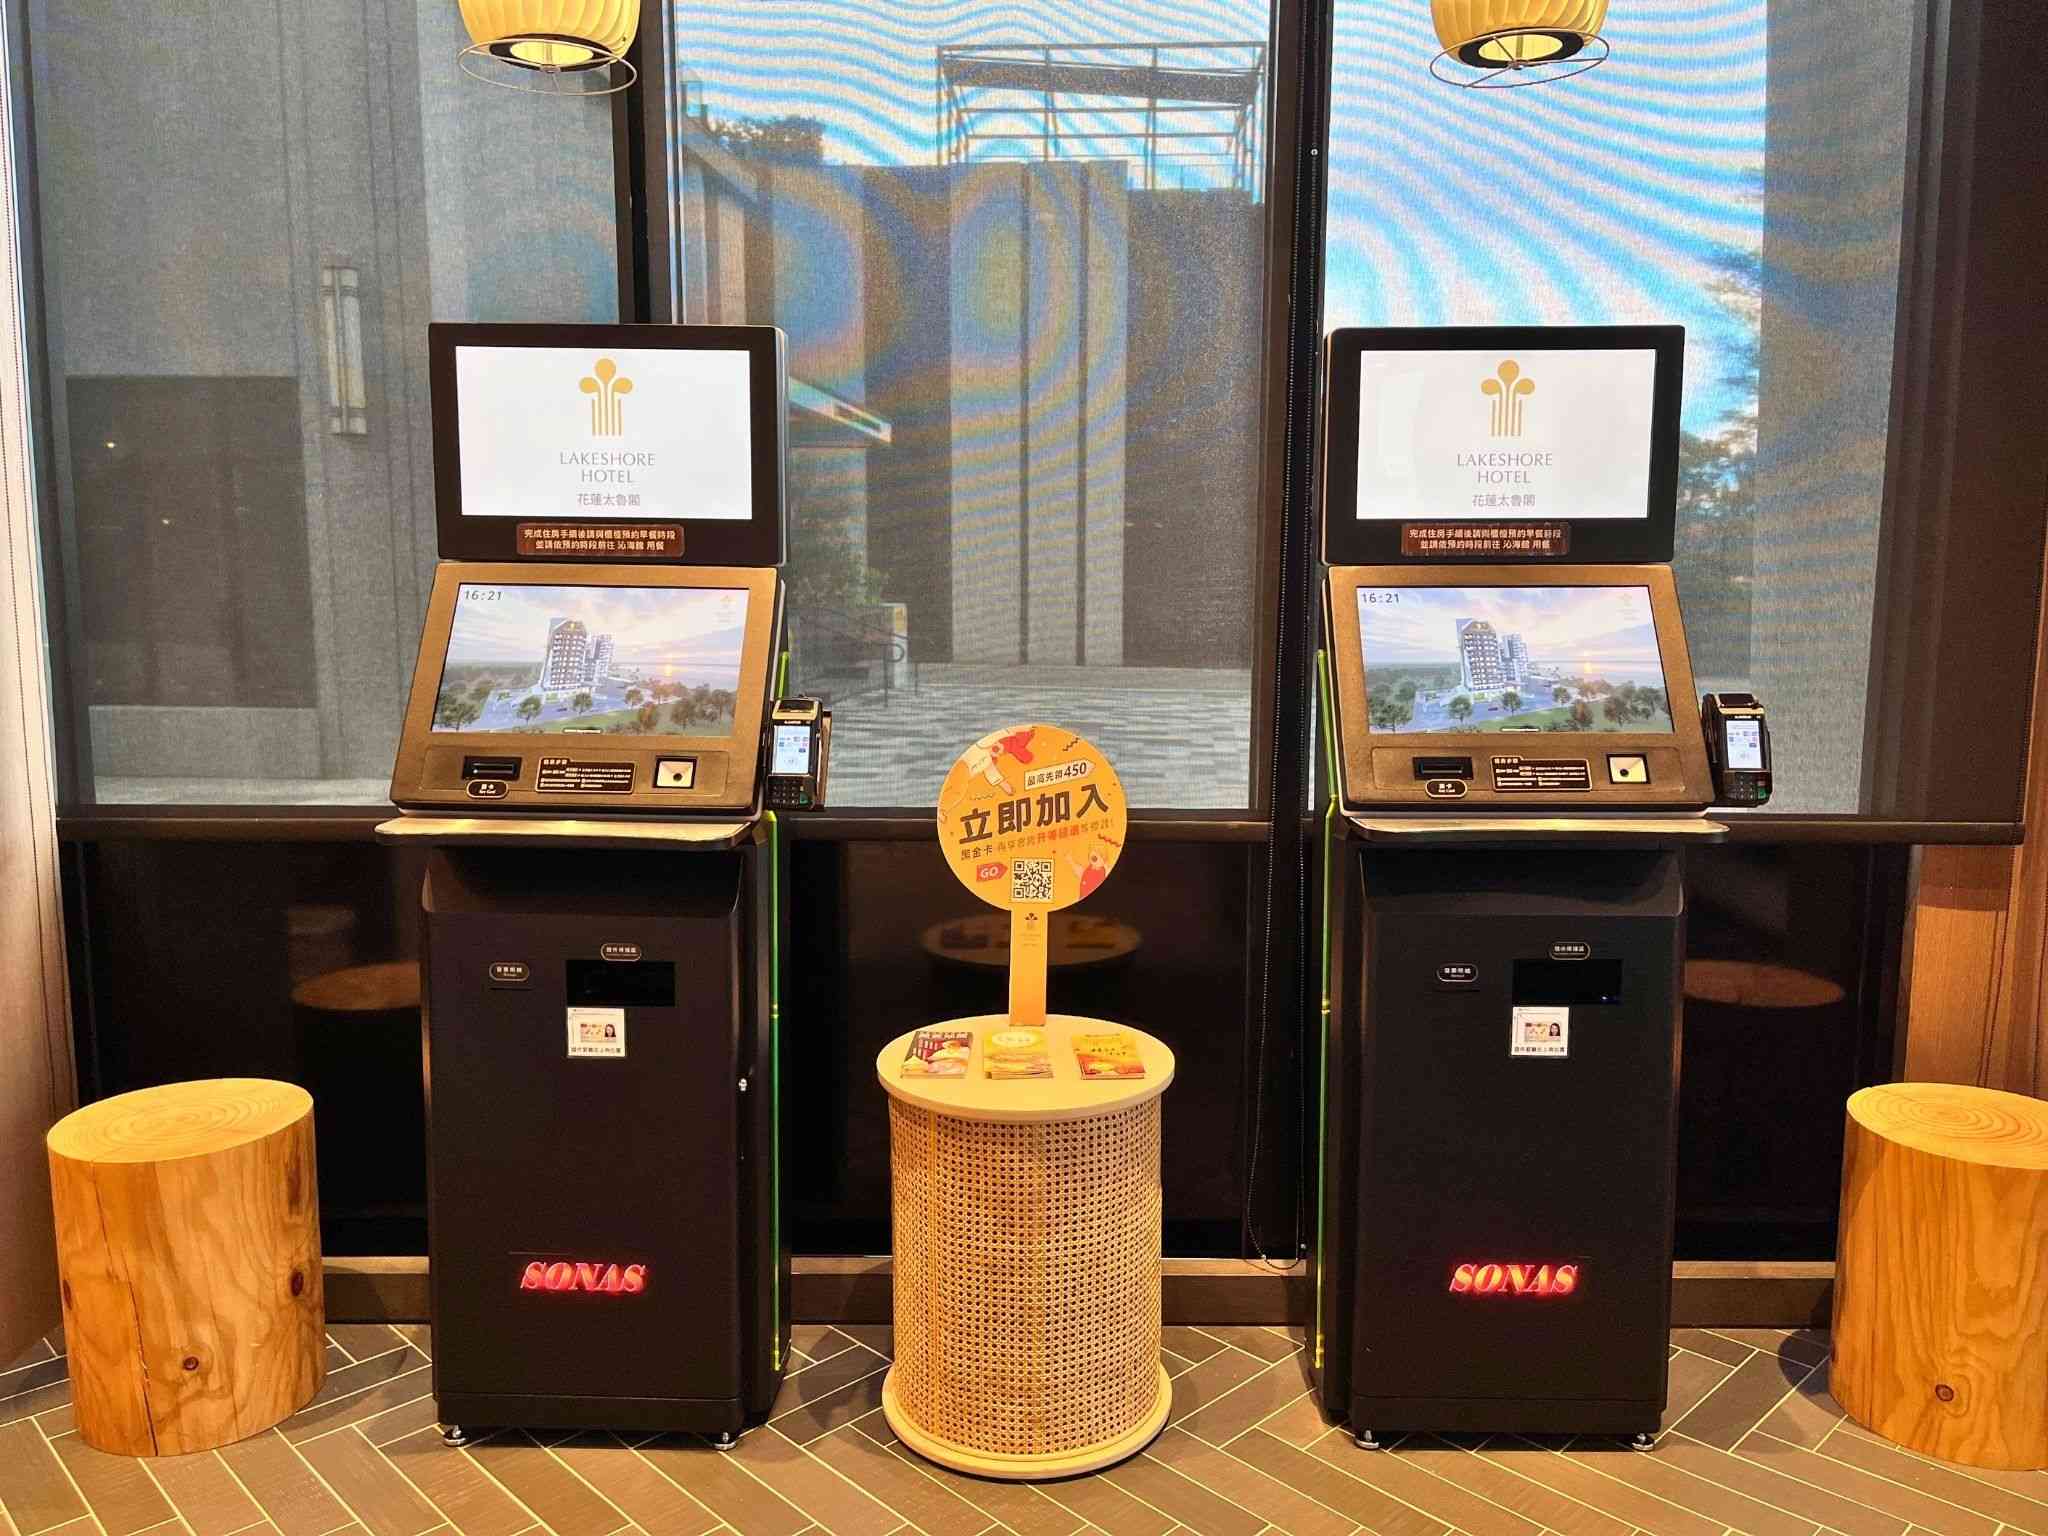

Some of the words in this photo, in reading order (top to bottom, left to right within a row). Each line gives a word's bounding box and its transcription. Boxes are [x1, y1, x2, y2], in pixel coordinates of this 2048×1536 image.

[559, 451, 656, 466] LAKESHORE
[1456, 452, 1553, 467] LAKESHORE
[580, 468, 634, 484] HOTEL
[1476, 470, 1532, 484] HOTEL
[576, 493, 640, 507] 花蓮太魯閣
[1471, 494, 1536, 508] 花蓮太魯閣
[464, 589, 503, 601] 16:21
[1361, 592, 1400, 603] 16:21
[959, 783, 1110, 845] 立即加入
[980, 865, 999, 880] GO
[520, 1261, 647, 1293] SONAS
[1449, 1263, 1579, 1294] SONAS
